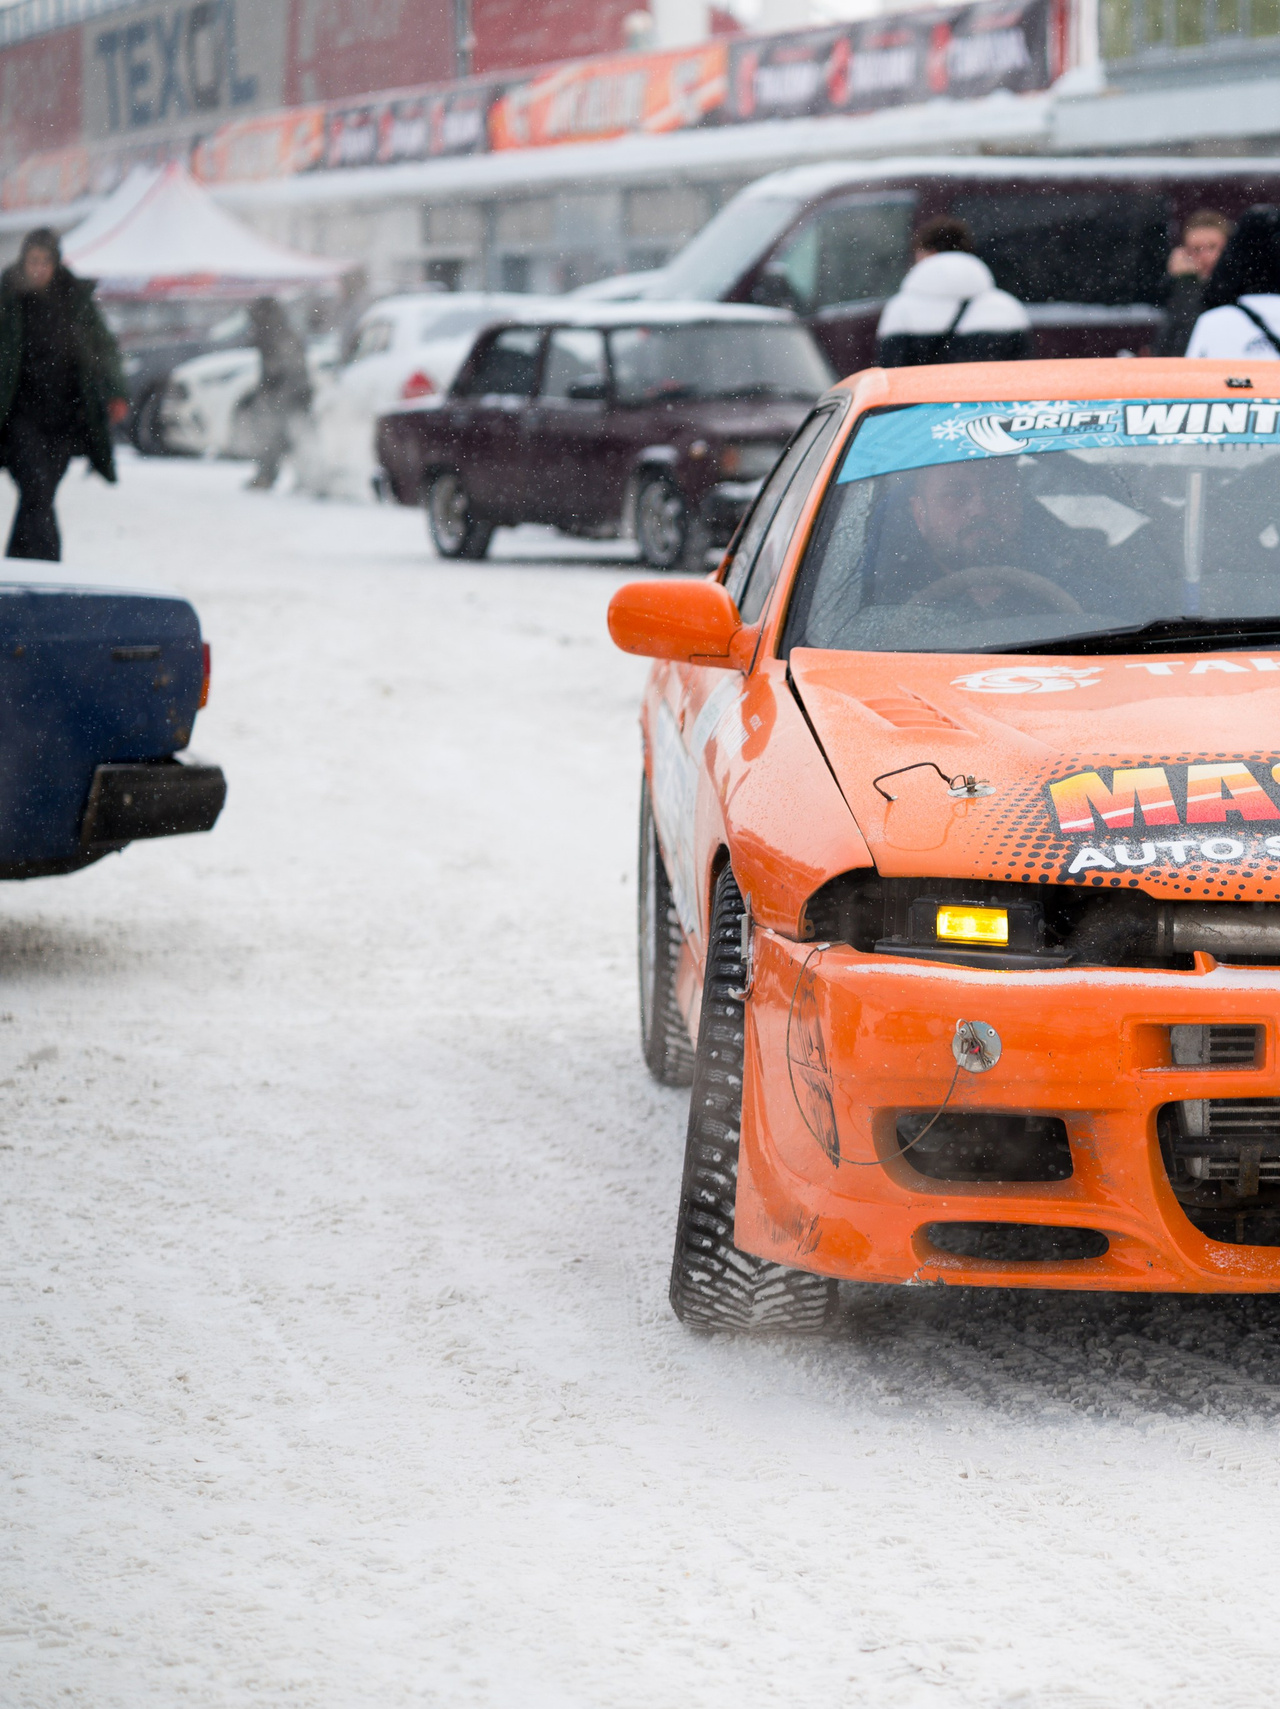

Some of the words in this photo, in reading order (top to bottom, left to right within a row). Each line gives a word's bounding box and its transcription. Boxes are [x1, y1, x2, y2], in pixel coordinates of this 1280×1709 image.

[1010, 410, 1118, 432] DRIFT
[1062, 424, 1105, 434] EXPO
[1067, 837, 1244, 874] AUTO
